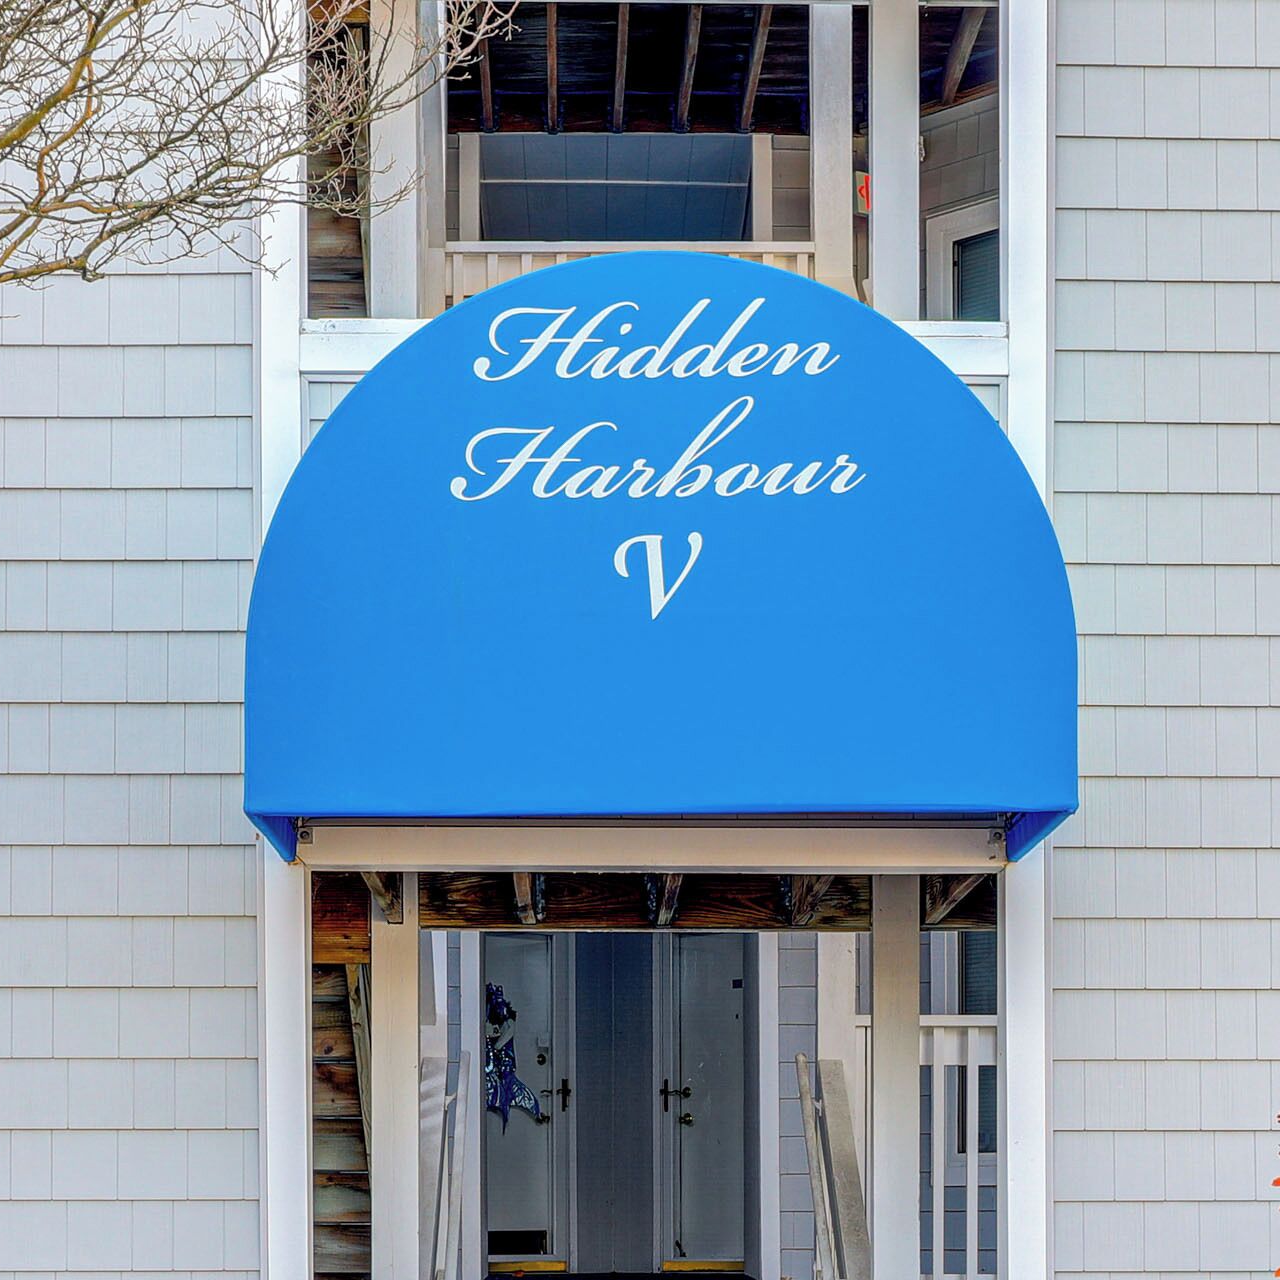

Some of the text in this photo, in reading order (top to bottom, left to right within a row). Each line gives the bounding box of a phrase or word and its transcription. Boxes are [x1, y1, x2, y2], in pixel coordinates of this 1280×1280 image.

[474, 298, 841, 383] Hidden
[451, 396, 867, 502] Harbour
[614, 532, 704, 620] V
